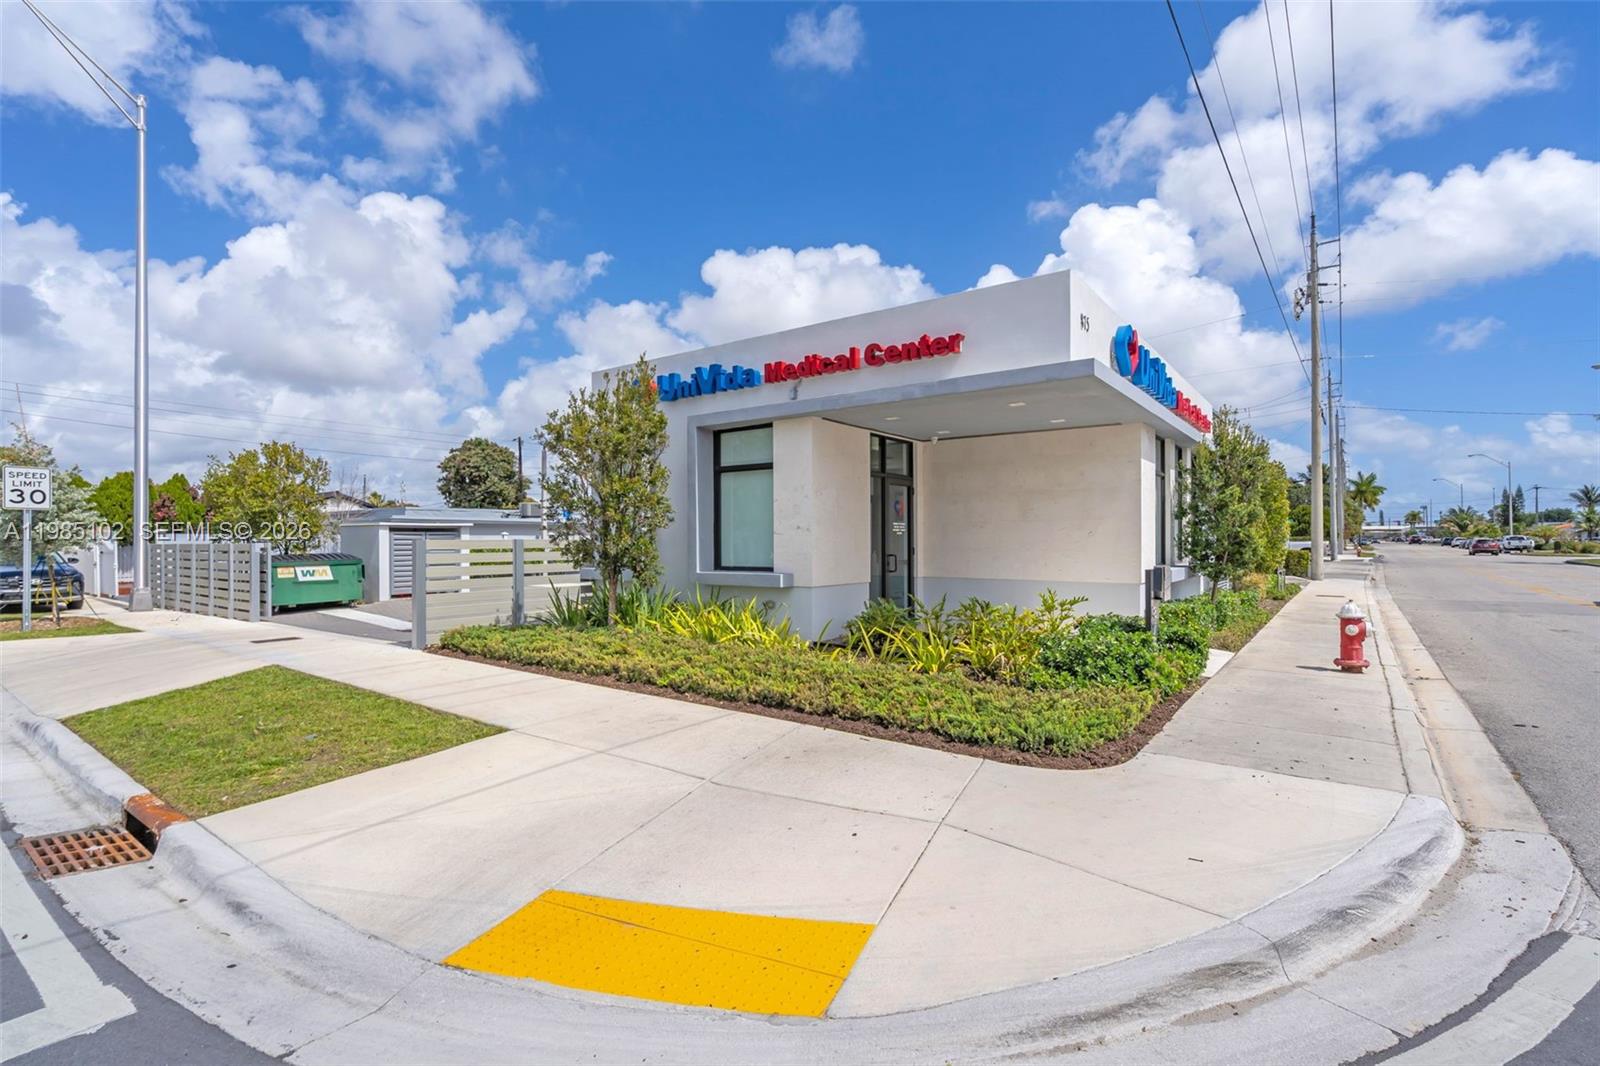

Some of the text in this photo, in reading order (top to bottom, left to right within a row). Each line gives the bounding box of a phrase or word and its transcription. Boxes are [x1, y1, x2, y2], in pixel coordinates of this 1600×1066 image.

[656, 332, 966, 402] UniVida Medical Center
[1132, 345, 1178, 409] UniVda
[8, 471, 47, 480] SPEED
[12, 480, 43, 488] LIMIT
[9, 488, 47, 505] 30
[301, 569, 328, 577] WM
